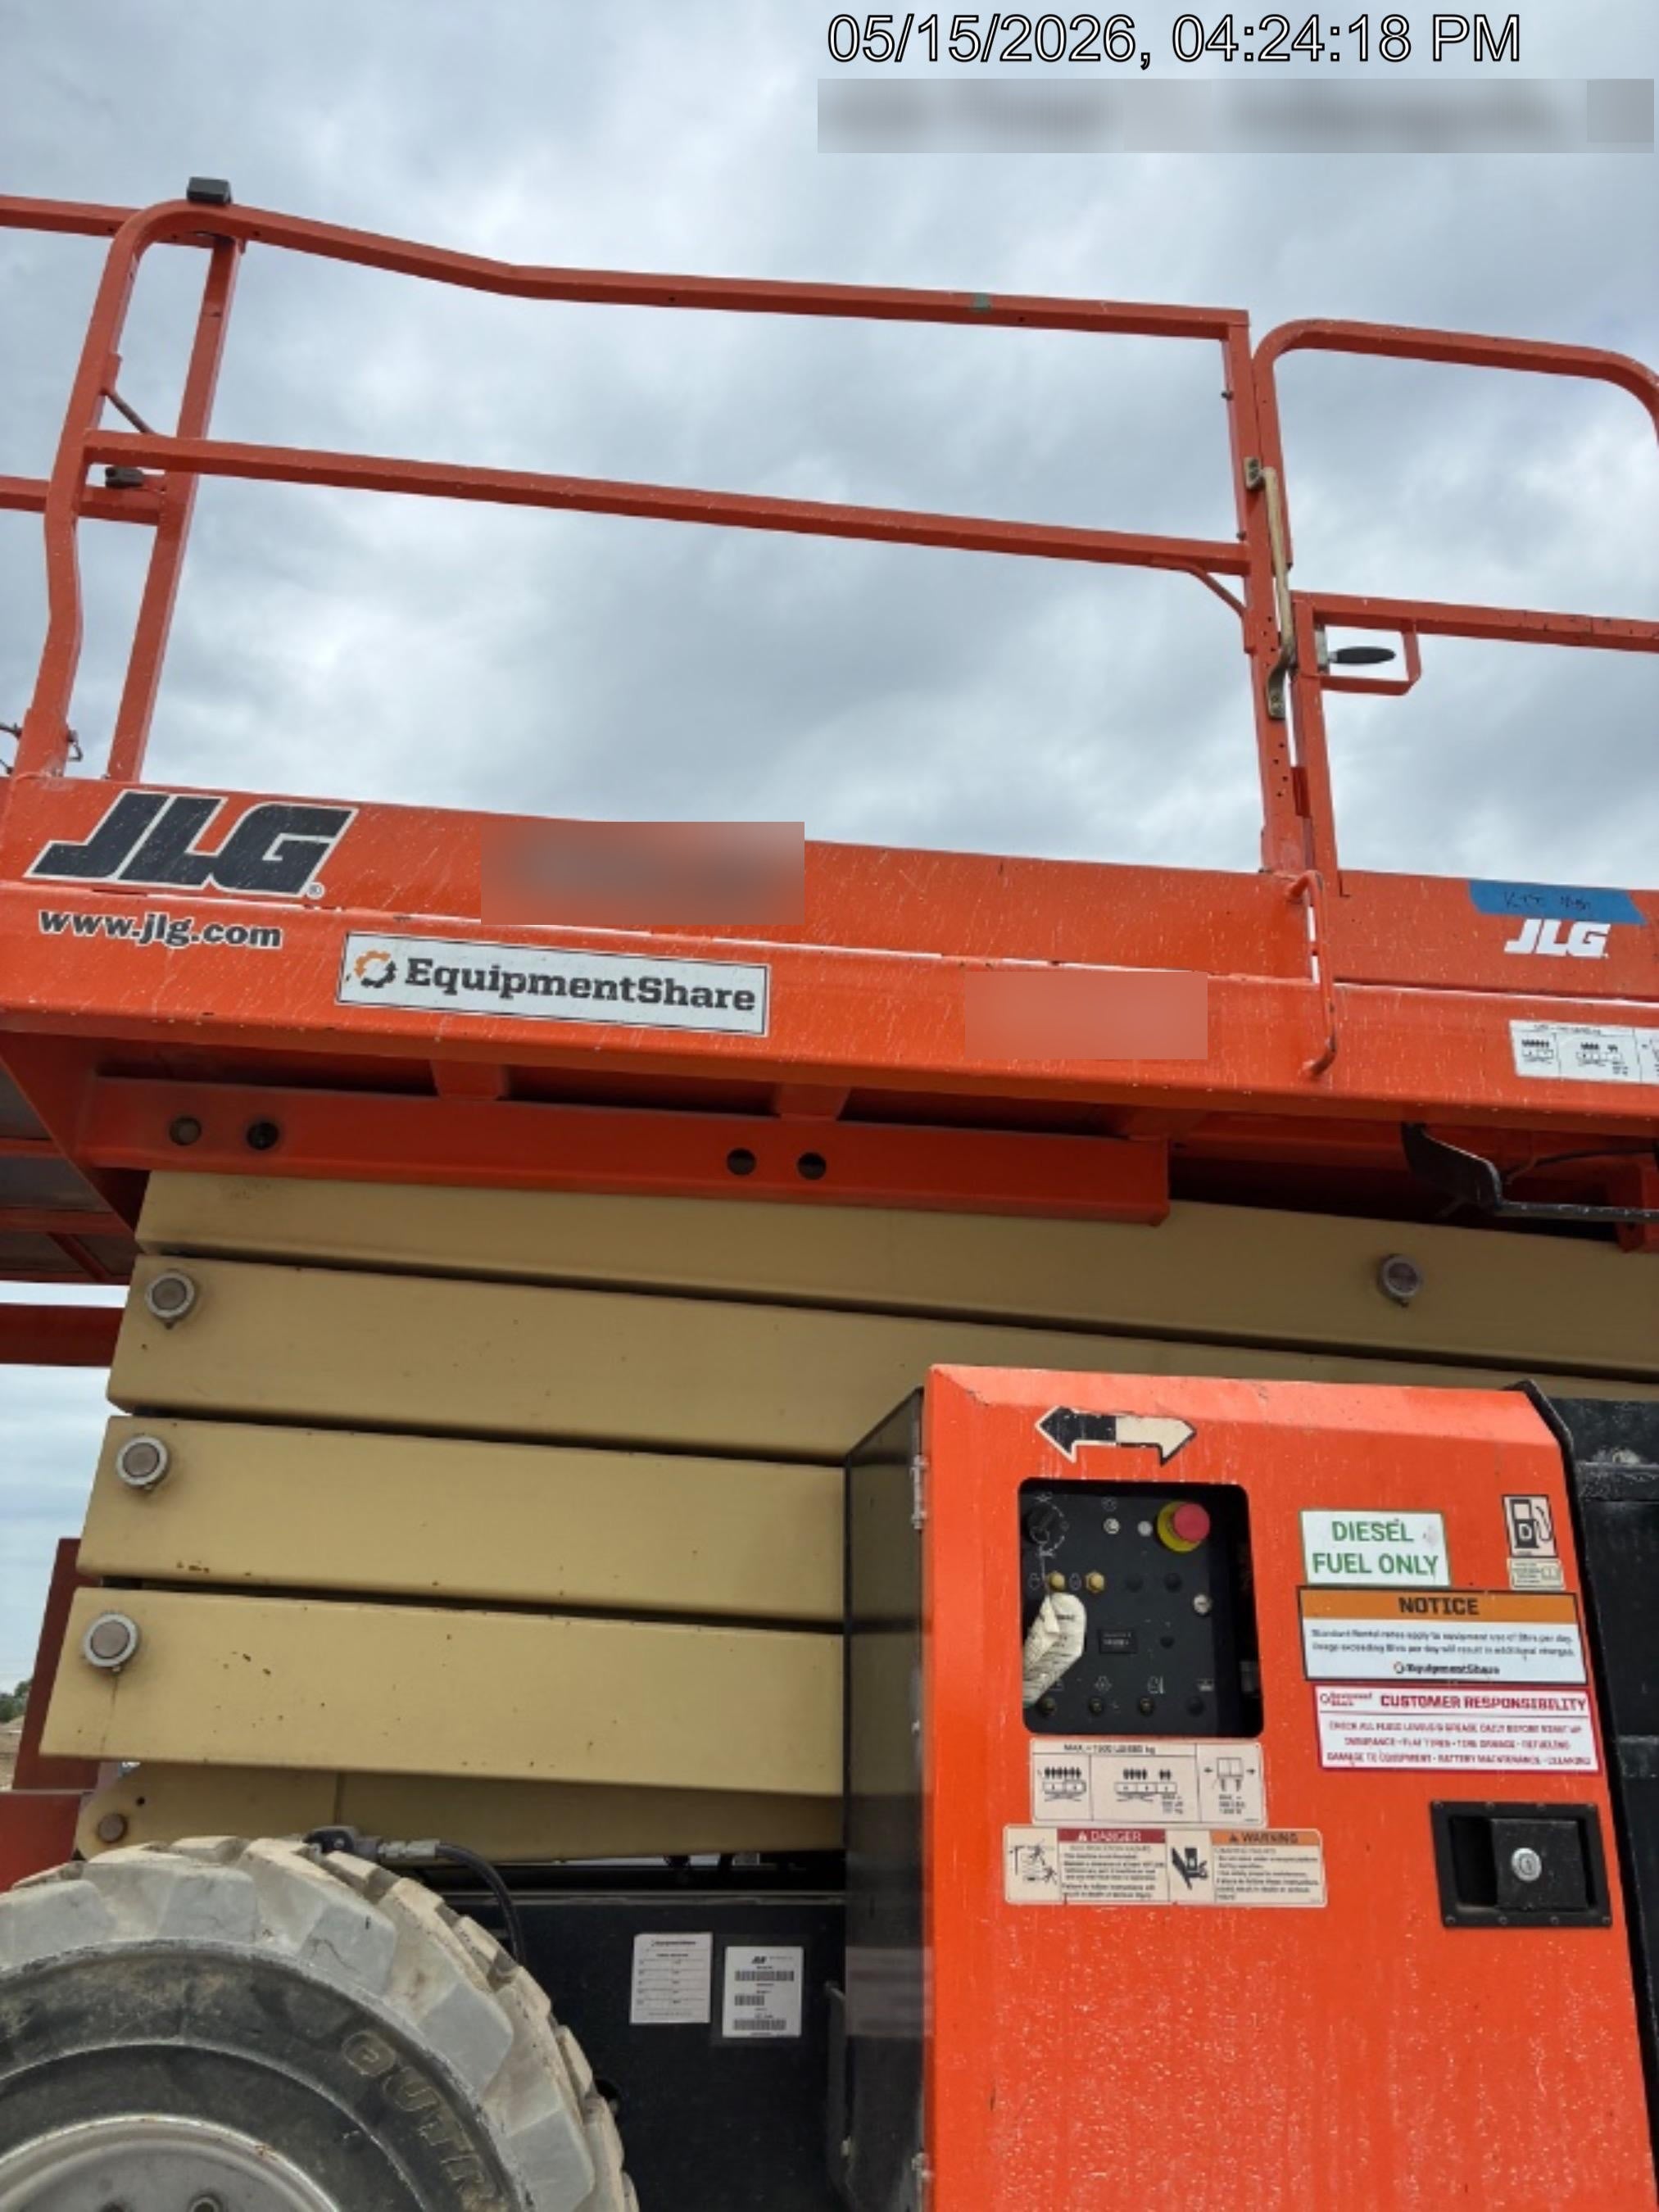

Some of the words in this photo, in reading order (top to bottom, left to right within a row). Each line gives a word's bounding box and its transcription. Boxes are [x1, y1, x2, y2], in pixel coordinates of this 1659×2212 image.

[39, 908, 283, 950] www.jlg.com
[406, 957, 757, 1013] EquipmentShare
[1330, 1521, 1415, 1542] DIESEL
[1312, 1552, 1373, 1574] FUEL
[1378, 1553, 1439, 1576] ONLY
[1398, 1597, 1480, 1616] NOTICE
[1380, 1694, 1462, 1709] CUSTOMER
[1464, 1696, 1587, 1711] RESPONSIBILITY
[1090, 1830, 1142, 1843] DANGER
[1243, 1832, 1299, 1844] WARNING
